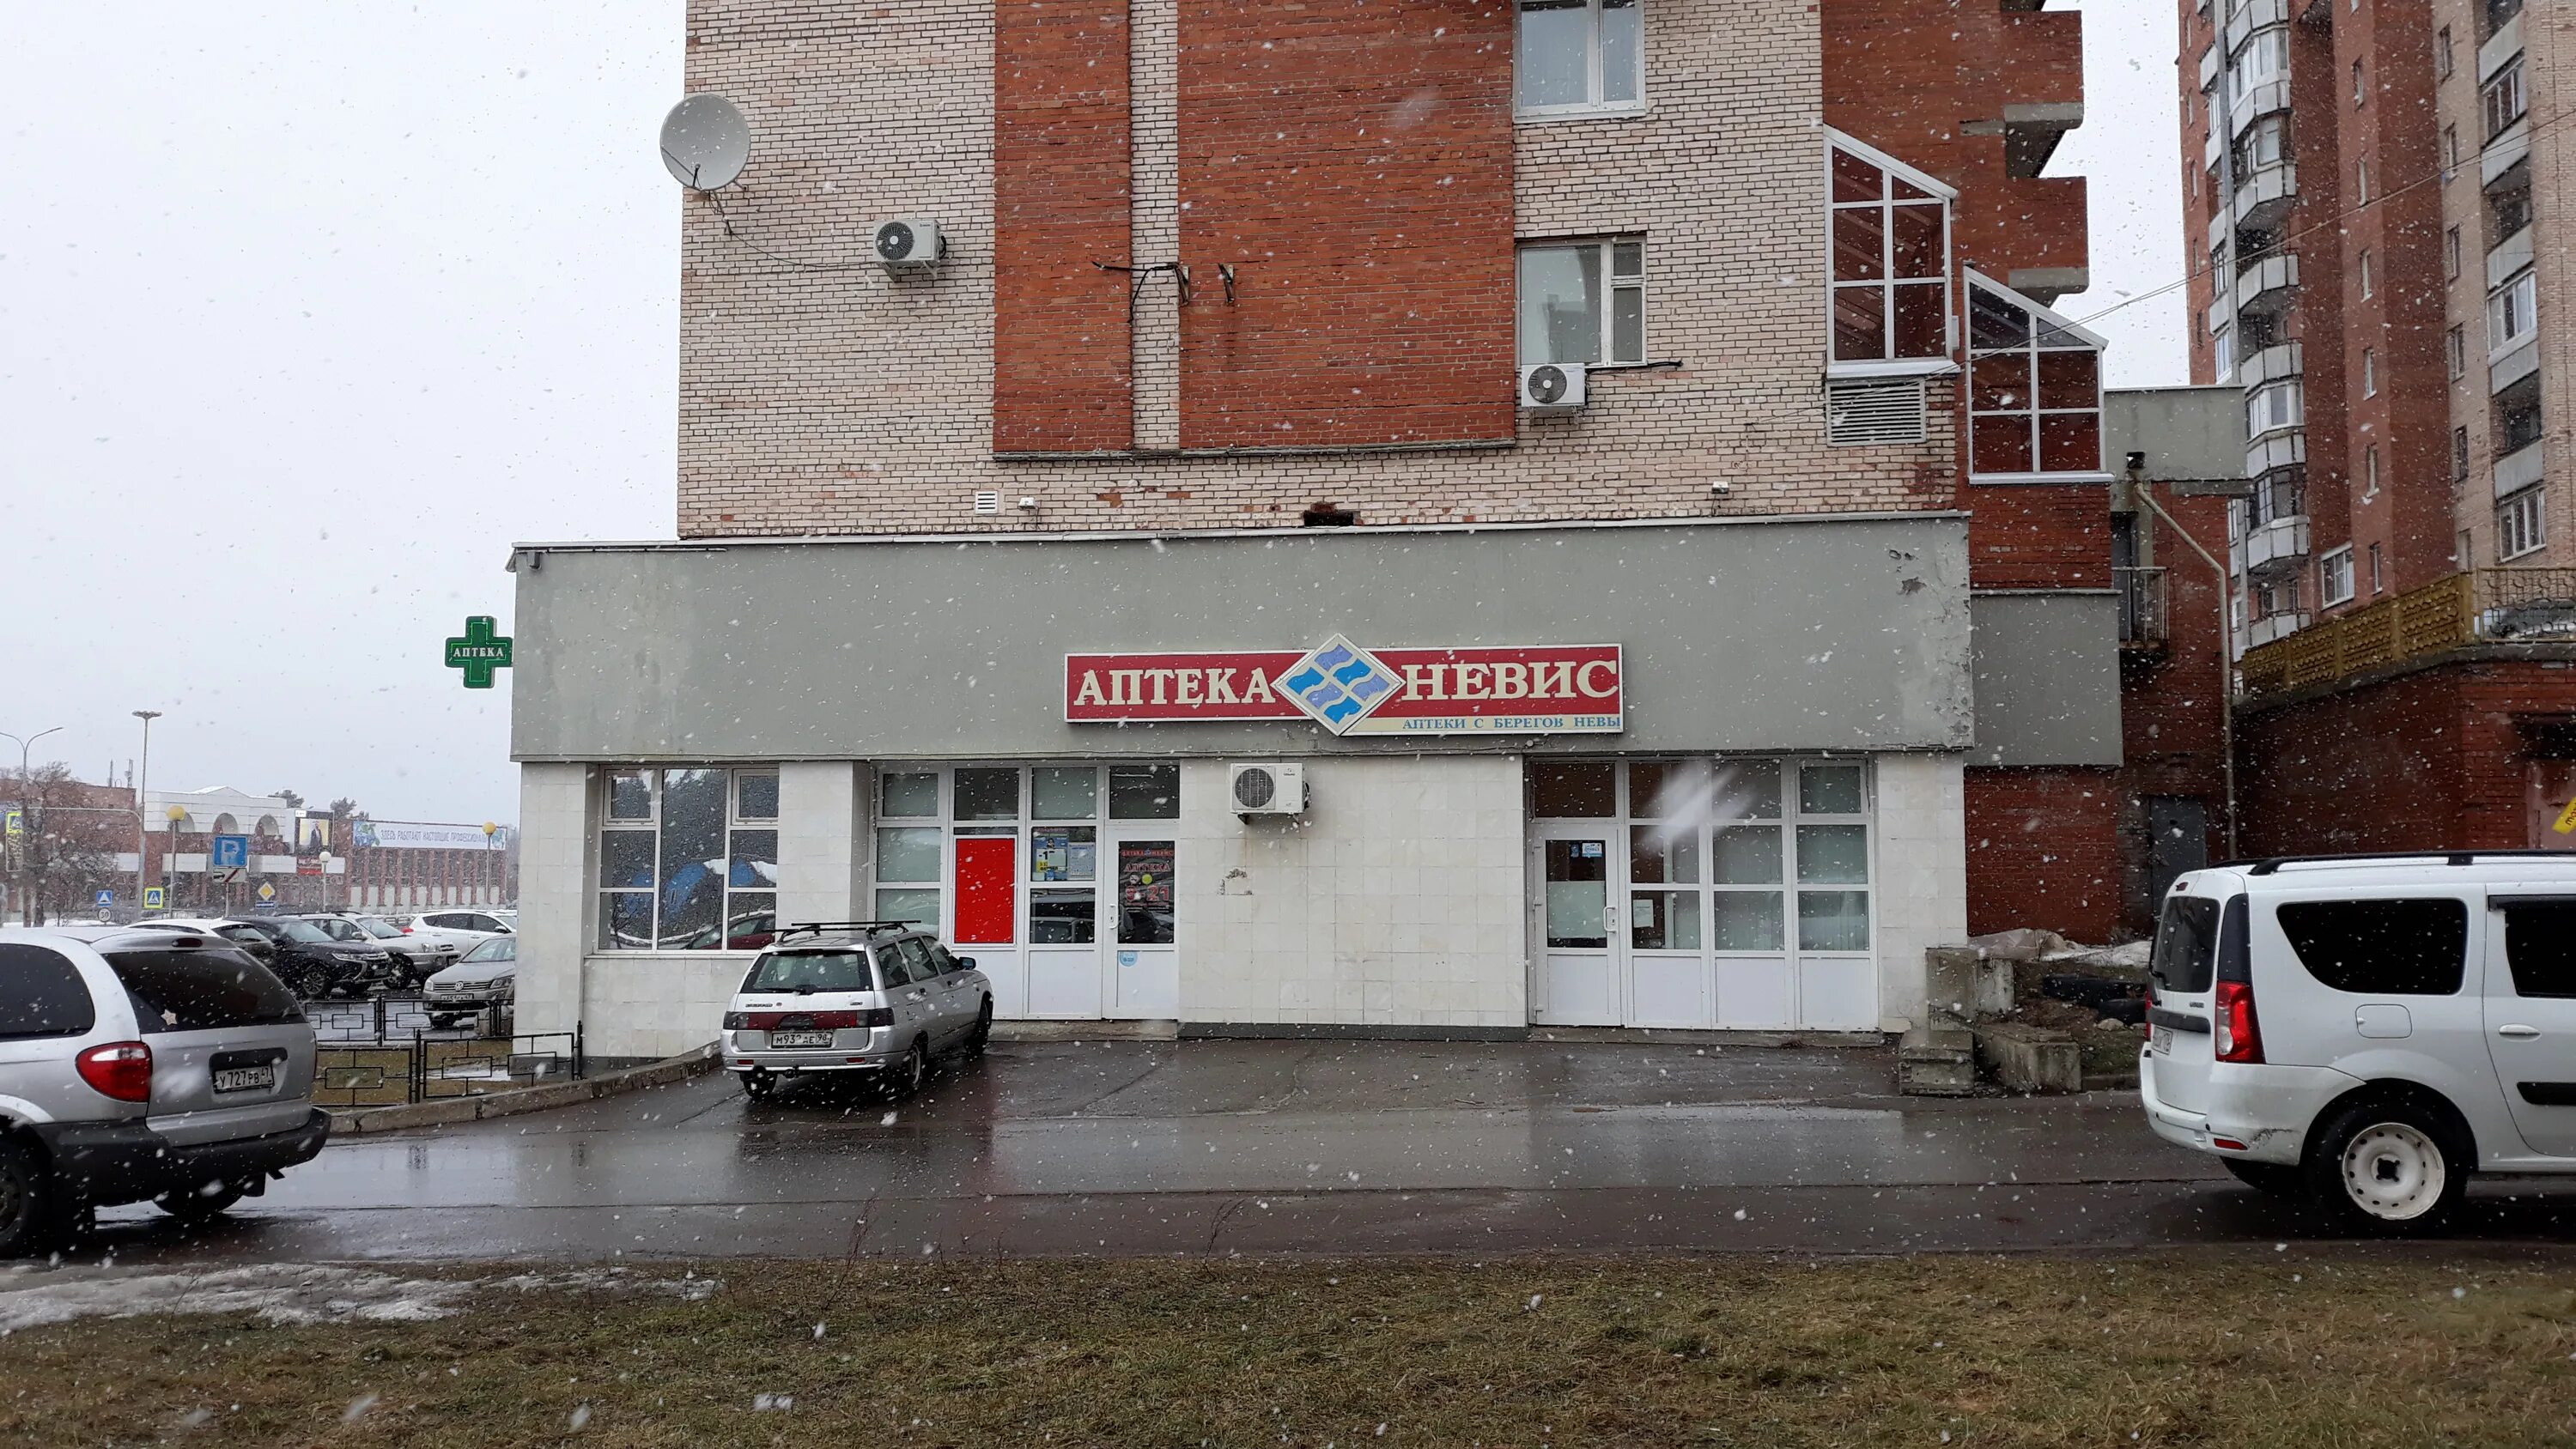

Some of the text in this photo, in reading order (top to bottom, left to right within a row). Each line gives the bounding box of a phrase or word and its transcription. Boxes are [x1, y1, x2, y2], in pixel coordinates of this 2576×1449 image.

[453, 647, 504, 657] АПТЕКА
[1073, 660, 1619, 706] АПТЕКА НЕВИС
[1402, 717, 1620, 730] АПТЕКИ С БЕРЕГОВ НЕВЫ
